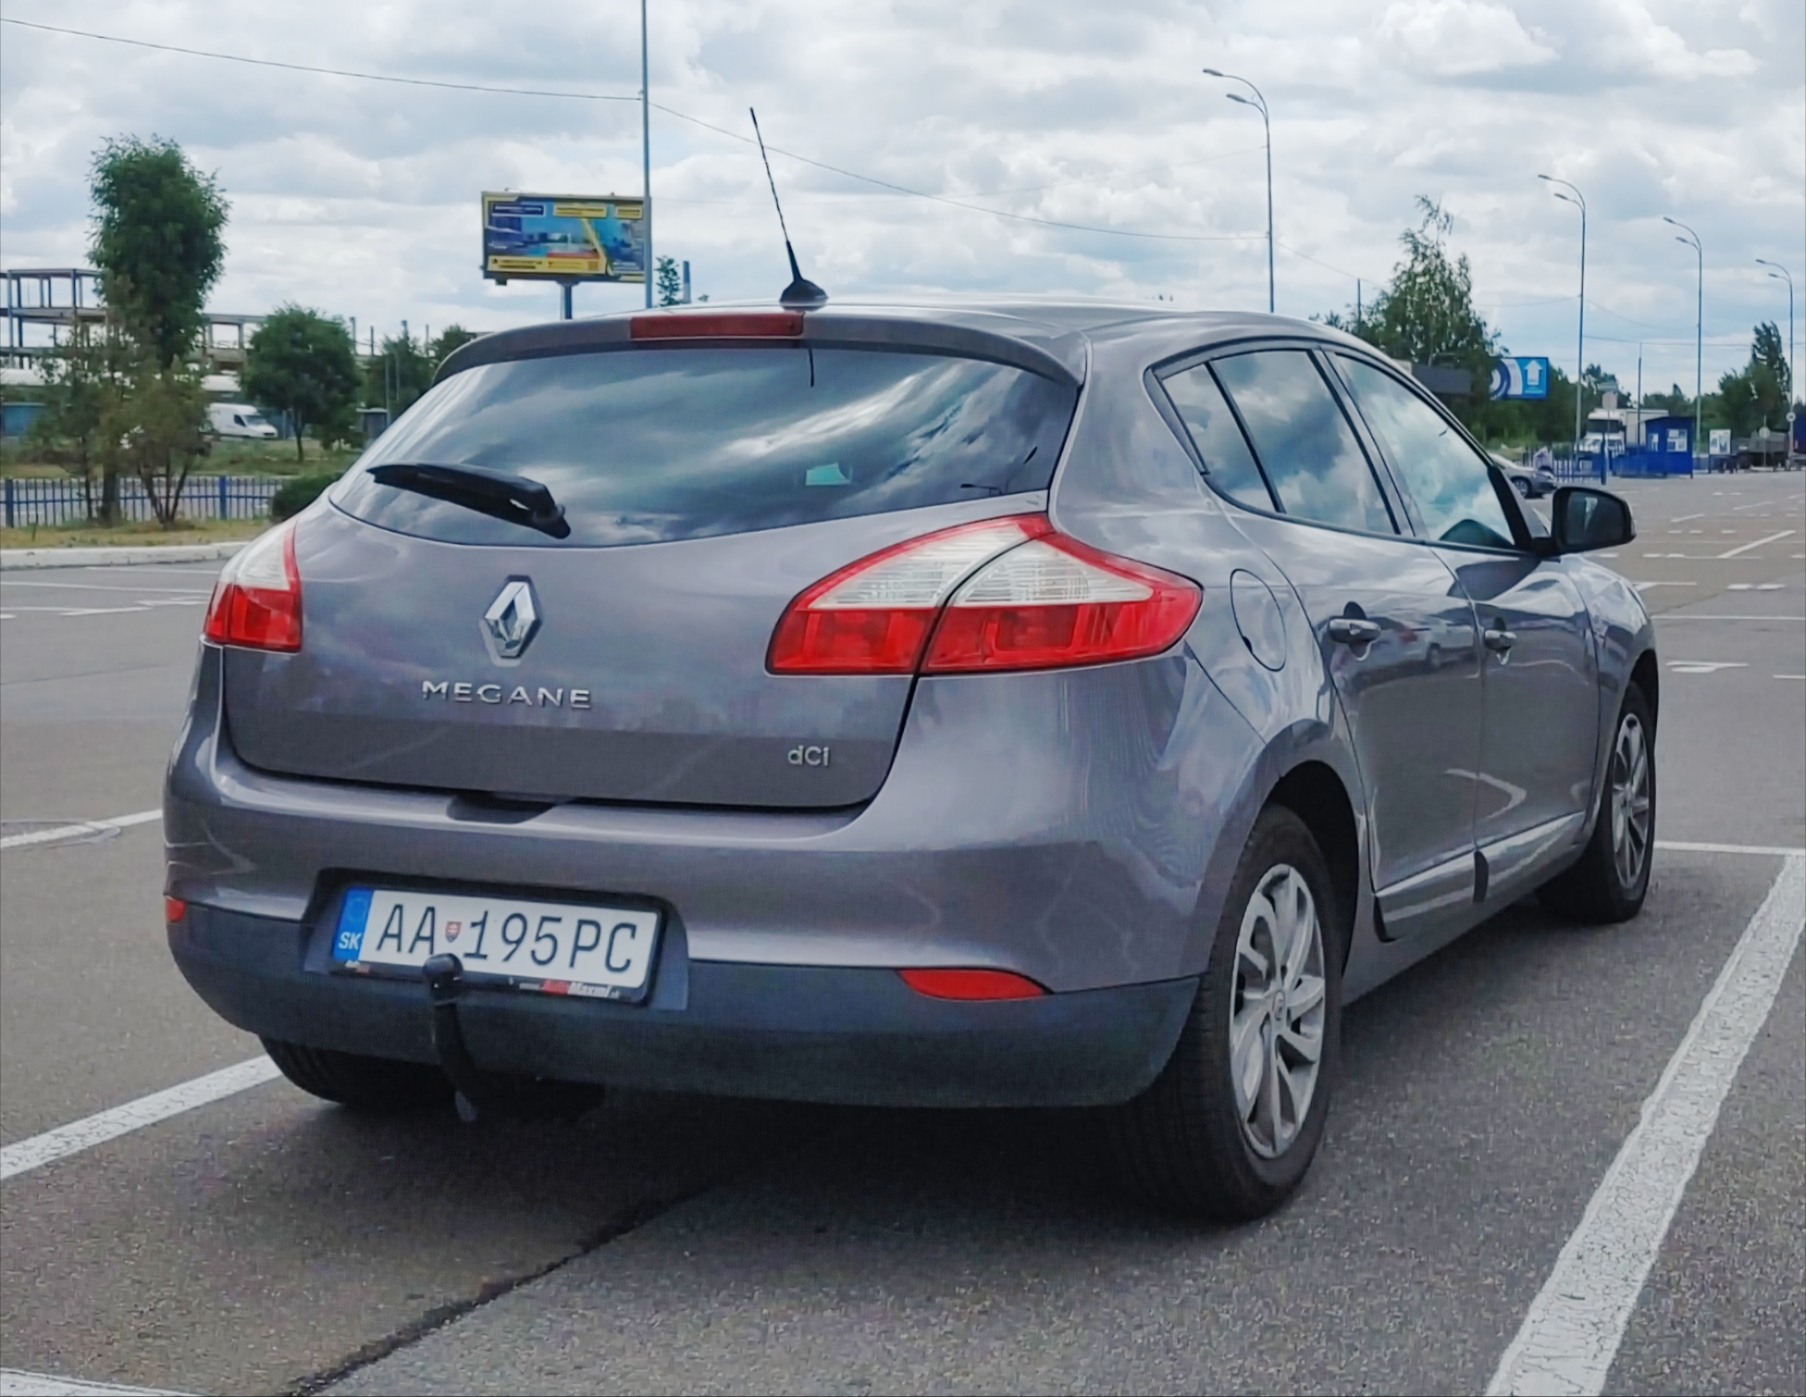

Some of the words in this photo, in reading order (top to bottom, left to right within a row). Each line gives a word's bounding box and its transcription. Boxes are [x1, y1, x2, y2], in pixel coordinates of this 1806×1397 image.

[422, 680, 591, 709] MEGANE
[338, 931, 362, 950] SK
[376, 904, 435, 955] AA
[463, 910, 637, 974] 195PC
